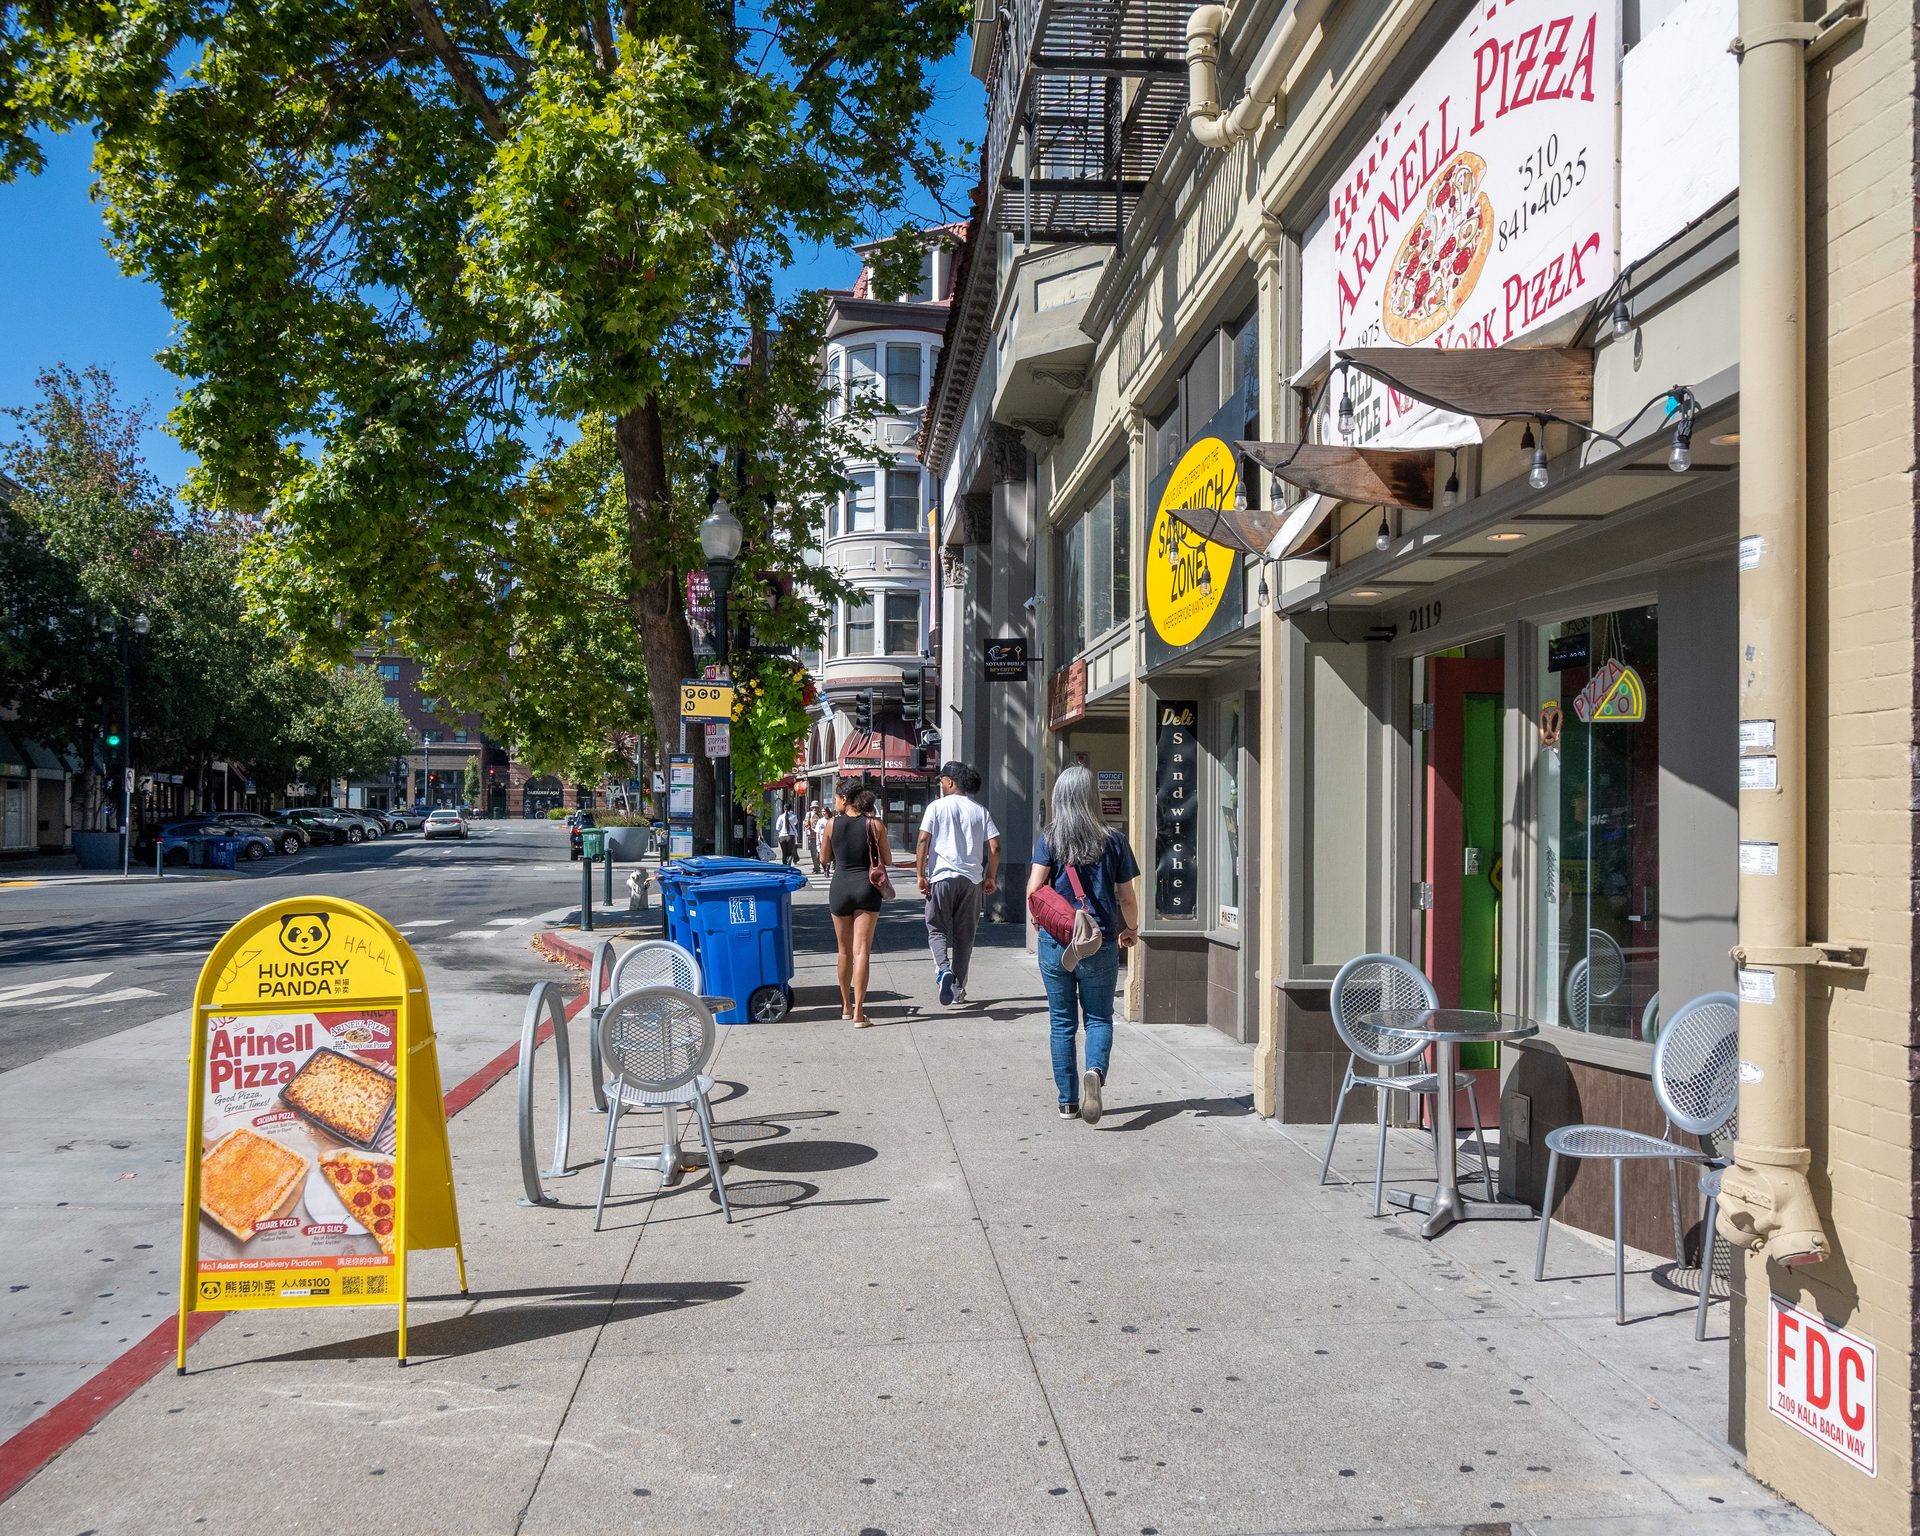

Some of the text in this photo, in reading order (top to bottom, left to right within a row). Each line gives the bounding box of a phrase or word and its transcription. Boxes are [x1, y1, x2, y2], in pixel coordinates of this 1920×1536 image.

[1337, 11, 1597, 345] ARINELL PIZZA
[1502, 231, 1601, 342] PIZZA
[1357, 318, 1381, 349] 1975
[1170, 550, 1203, 603] ZONE
[1409, 600, 1442, 634] 2119
[706, 668, 715, 678] NO
[1573, 661, 1624, 719] PIZZA
[1161, 708, 1195, 726] Deli
[706, 724, 716, 735] NO
[1170, 731, 1185, 906] Sandwiches
[343, 935, 396, 976] HALAL
[258, 959, 350, 979] HUNGRY
[258, 979, 332, 998] PANDA
[331, 1020, 390, 1036] ARINELL PIZZA
[210, 1023, 314, 1060] Arinell
[210, 1058, 297, 1094] Pizza
[214, 1090, 262, 1105] Good Pizza,
[224, 1098, 271, 1113] Great Times!
[278, 1111, 295, 1121] PIZZA
[255, 1218, 297, 1231] SQUARE PIZZA
[307, 1225, 344, 1235] PIZZA SLICE
[200, 1259, 323, 1271] No.1 Asian Food Delivery Platform
[225, 1280, 276, 1293] 熊猫外卖
[1777, 1310, 1866, 1433] FDC
[1777, 1391, 1866, 1459] 2109 KALA BAGAI WAY
